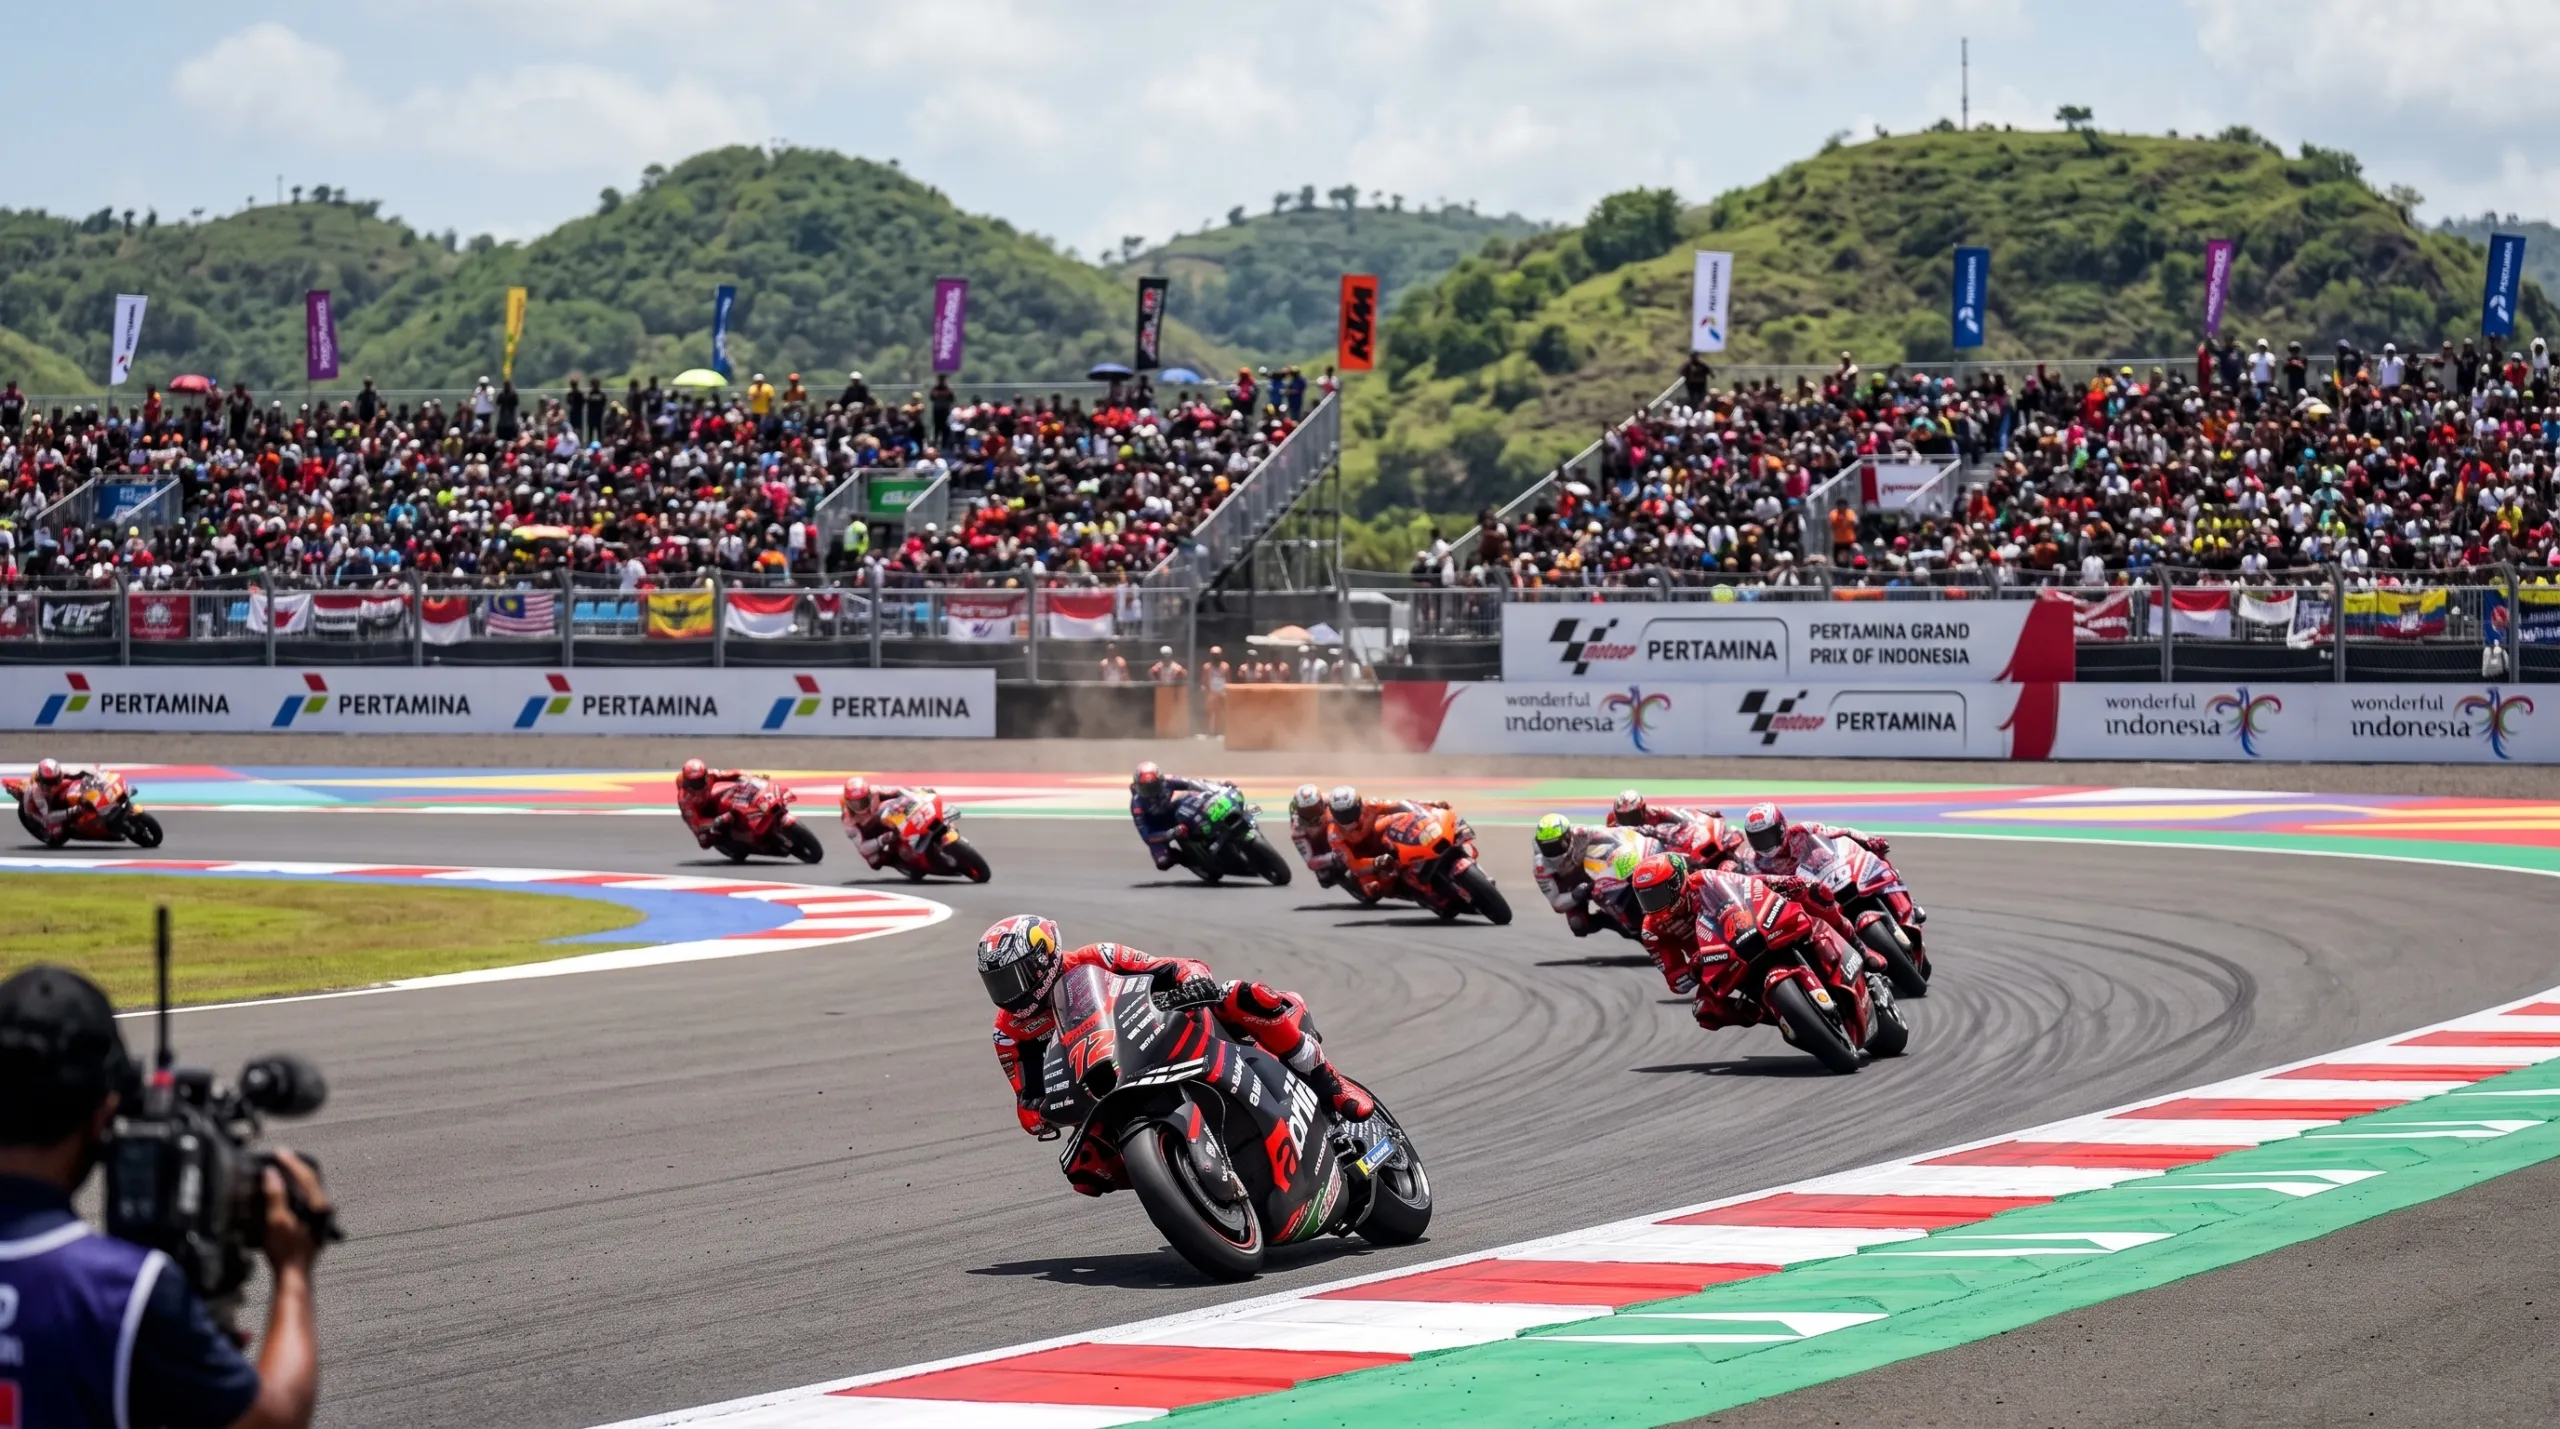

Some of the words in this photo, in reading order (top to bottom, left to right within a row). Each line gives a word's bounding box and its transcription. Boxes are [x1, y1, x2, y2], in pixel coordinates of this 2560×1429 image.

[1347, 285, 1373, 364] KTM
[1810, 623, 1906, 641] PERTAMINA
[1910, 623, 1970, 641] GRAND
[1647, 639, 1778, 661] PERTAMINA
[1810, 647, 1848, 665] PRIX
[1852, 647, 1875, 665] OF
[1878, 647, 1970, 665] INDONESIA
[100, 693, 230, 715] PERTAMINA
[339, 694, 471, 716] PERTAMINA
[582, 695, 718, 717] PERTAMINA
[832, 696, 970, 718] PERTAMINA
[1506, 691, 1591, 708] wonderful
[2105, 692, 2196, 710] wonderful
[2351, 694, 2444, 712] wonderful
[1505, 708, 1614, 733] indonesia
[1836, 711, 1957, 732] PERTAMINA
[2105, 711, 2220, 736] indonesia
[2351, 713, 2470, 738] indonesia
